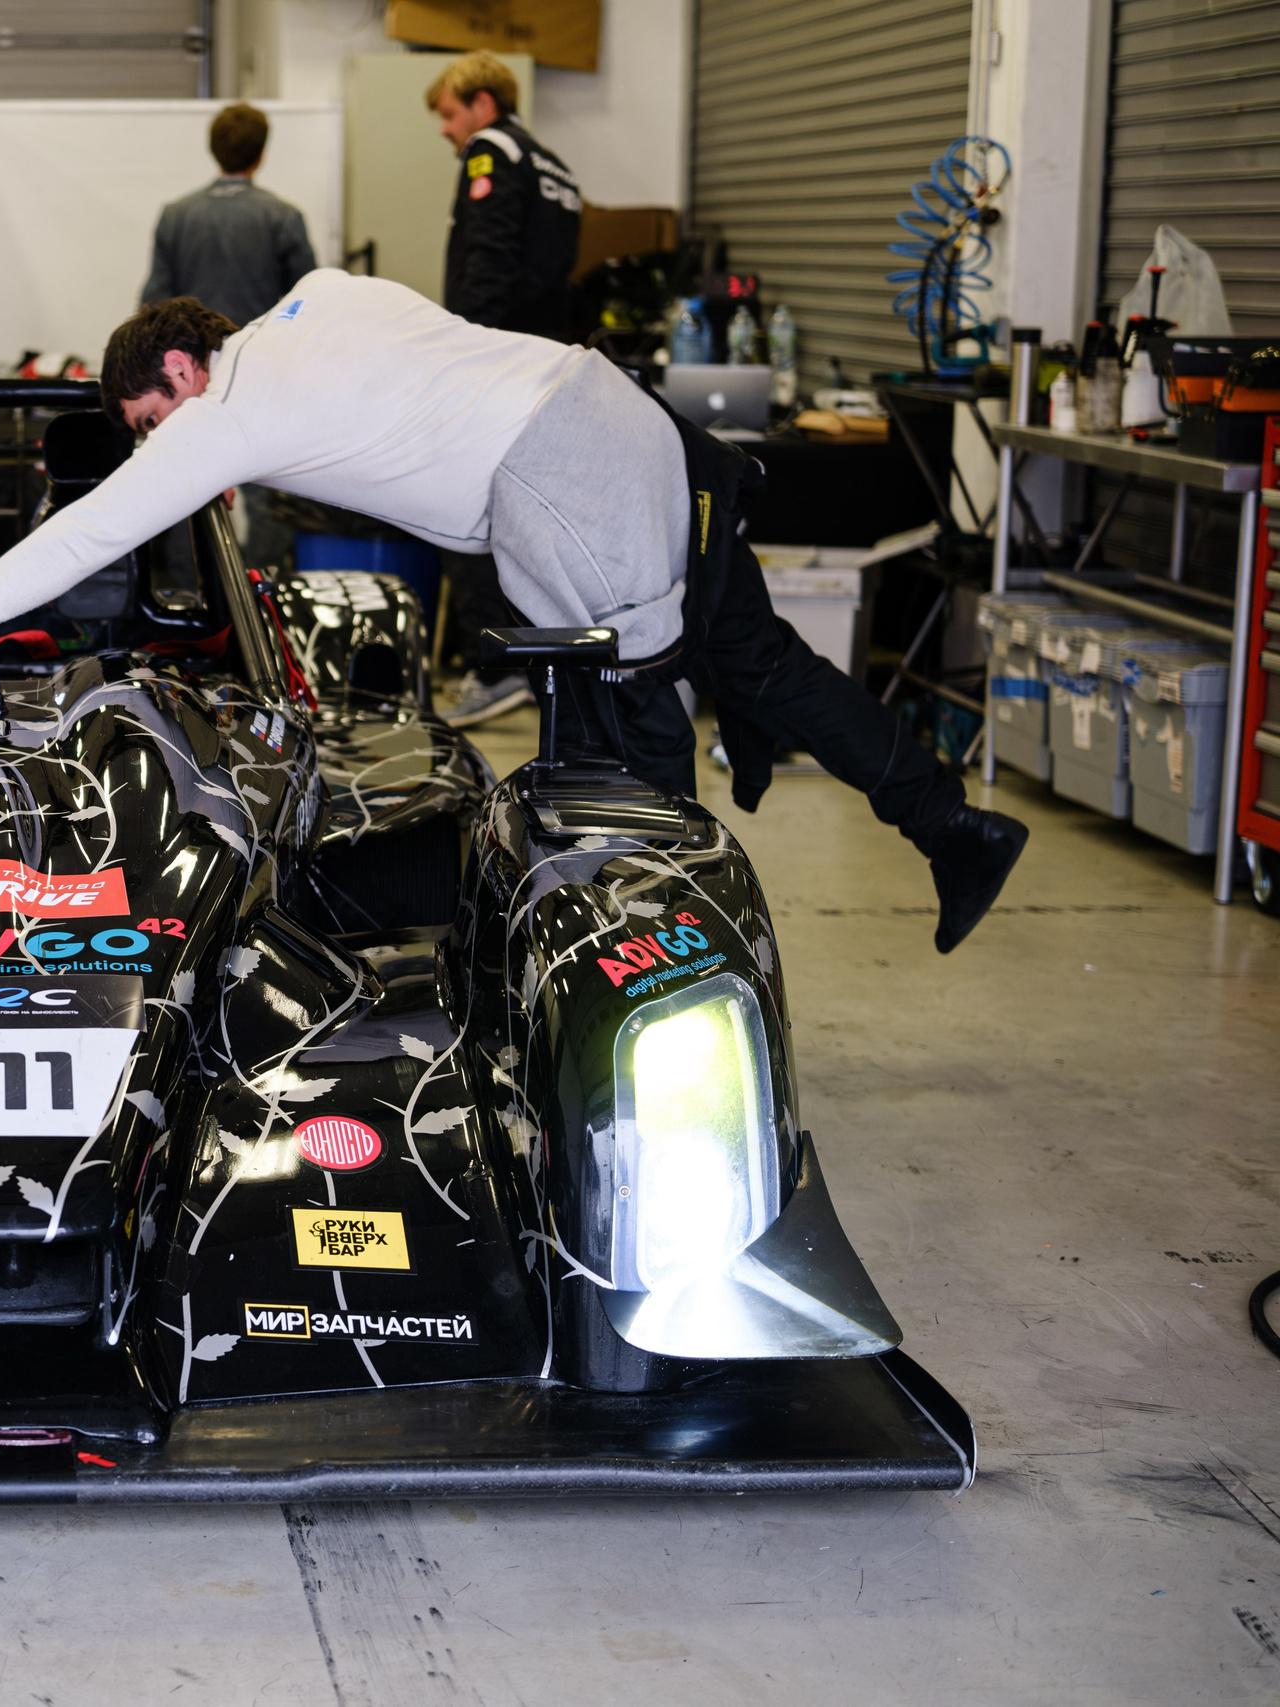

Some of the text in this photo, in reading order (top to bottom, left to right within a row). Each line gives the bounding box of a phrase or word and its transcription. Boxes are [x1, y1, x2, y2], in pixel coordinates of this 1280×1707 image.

[43, 958, 153, 973] solutions
[625, 952, 727, 998] digital marketing solutions
[300, 1120, 374, 1165] ЮНОСТЬ
[324, 1219, 376, 1233] РУКИ
[328, 1244, 366, 1257] БАР
[245, 1310, 473, 1339] МИР ЗАПЧАСТЕЙ
